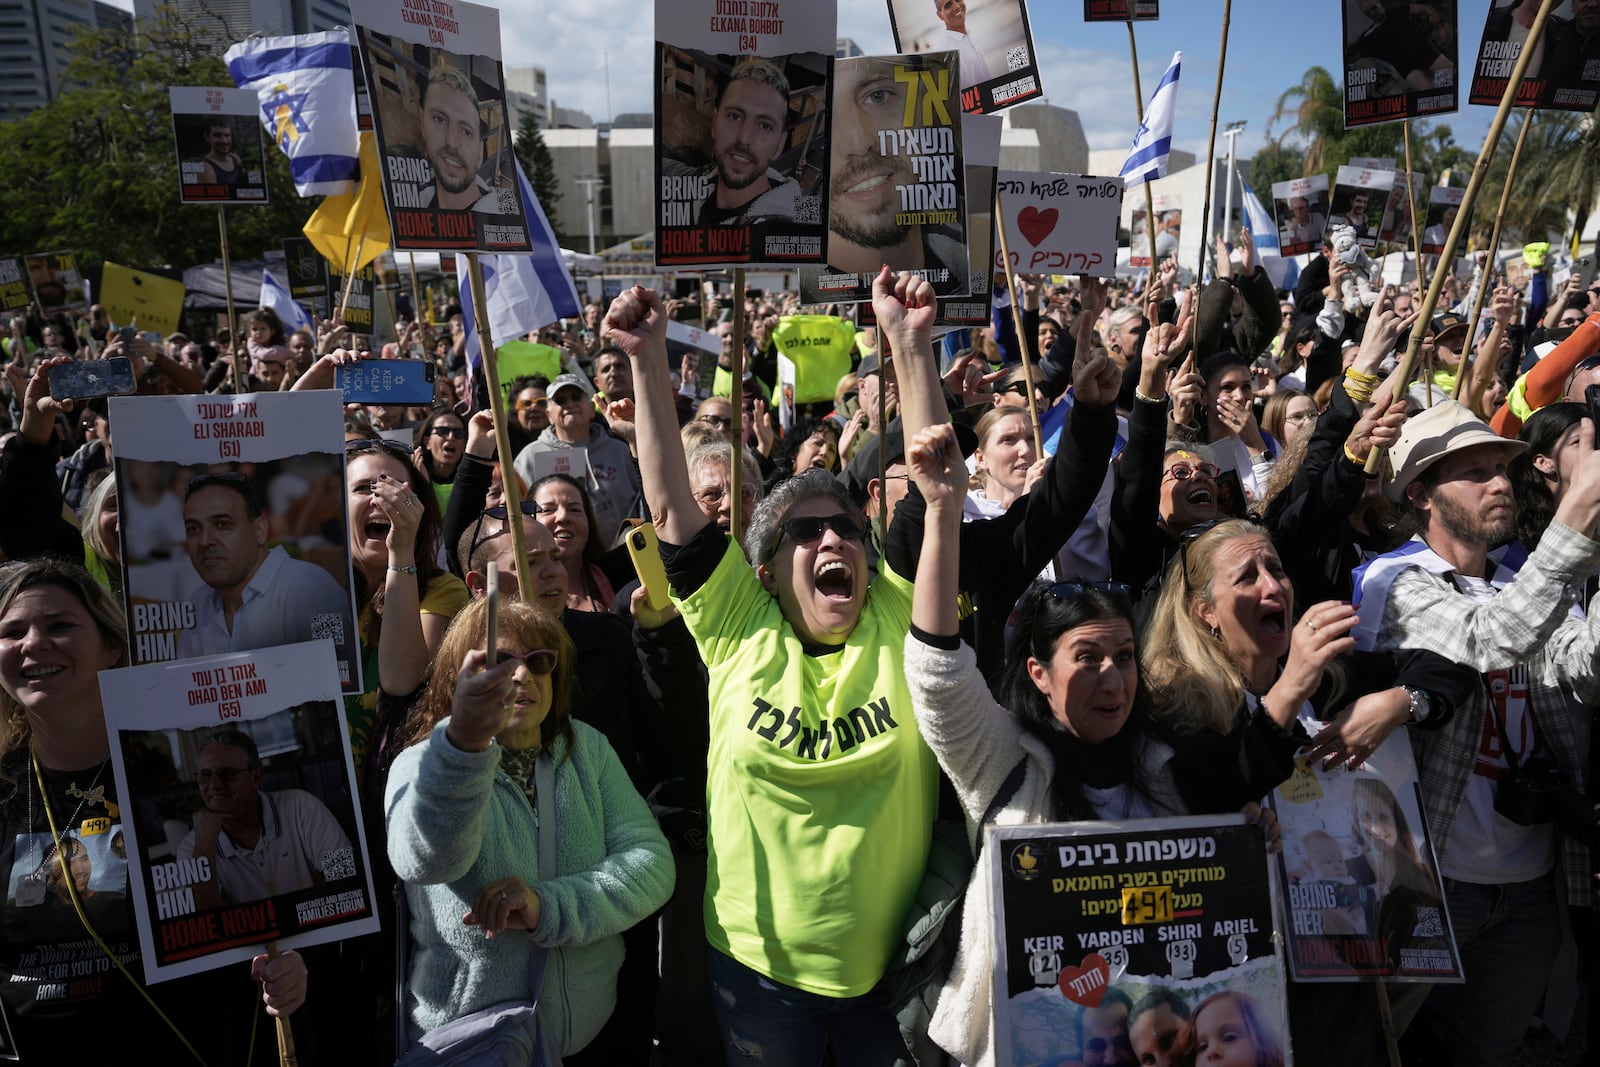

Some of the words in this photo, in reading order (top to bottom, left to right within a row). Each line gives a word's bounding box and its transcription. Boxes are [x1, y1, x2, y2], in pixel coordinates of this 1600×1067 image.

[716, 0, 748, 16] בוחבוט
[750, 1, 779, 18] אלקנה
[402, 10, 433, 27] ELKANA
[434, 16, 460, 35] BOHBOT
[711, 17, 747, 33] ELKANA
[749, 18, 784, 35] BOHBOT
[738, 34, 757, 51] (34)
[1482, 40, 1521, 60] BRING
[1348, 67, 1377, 86] BRING
[1480, 59, 1516, 78] THEM
[894, 66, 952, 127] אל
[1348, 85, 1367, 102] HIM
[1349, 100, 1377, 118] HOME
[1378, 94, 1407, 115] NOW!
[878, 128, 954, 157] תשאירו
[182, 162, 205, 173] BRING
[182, 173, 198, 184] HIM
[387, 156, 431, 184] BRING
[911, 155, 955, 182] אותי
[392, 182, 420, 208] HIM
[662, 175, 710, 200] BRING
[896, 182, 957, 211] מאחור
[1076, 182, 1117, 198] סליחה
[396, 212, 436, 237] HOME
[437, 212, 476, 238] NOW!
[662, 202, 690, 226] HIM
[928, 211, 958, 224] אלקנה
[662, 230, 704, 254] HOME
[708, 226, 750, 252] NOW!
[765, 244, 796, 256] FAMILIES
[796, 243, 821, 256] FORUM
[1030, 252, 1102, 270] ברוכים
[355, 368, 363, 390] FUCK
[371, 368, 380, 392] CALM
[383, 370, 392, 390] KEEP
[197, 404, 234, 420] שרעבי
[238, 402, 258, 418] אלי
[194, 423, 210, 440] ELI
[213, 422, 264, 438] SHARABI
[219, 440, 241, 458] (51)
[134, 602, 196, 632] BRING
[136, 632, 177, 662] HIM
[192, 670, 212, 686] עמי
[216, 668, 226, 685] בן
[228, 664, 257, 680] אוהד
[188, 689, 218, 706] OHAD
[220, 684, 243, 702] BEN
[246, 679, 268, 698] AMI
[218, 702, 242, 720] (55)
[747, 697, 802, 748] לבד
[832, 696, 899, 752] אתם
[798, 720, 832, 760] לא
[1058, 842, 1118, 868] ביבס
[1126, 836, 1216, 864] משפחת
[152, 855, 212, 893] BRING
[1052, 874, 1115, 894] החמאס
[1118, 870, 1158, 888] בשבי
[1162, 866, 1226, 888] מוחזקים
[156, 887, 196, 920] HIM
[296, 896, 325, 912] HOSTAGES
[325, 894, 338, 904] AND
[338, 889, 363, 902] MISSING
[1290, 884, 1336, 910] BRING
[298, 904, 335, 924] FAMILIES
[336, 897, 365, 916] FORUM
[161, 913, 218, 951] HOME
[222, 900, 278, 936] NOW!
[1077, 928, 1145, 948] YARDEN
[1157, 922, 1202, 942] SHIRI
[1213, 918, 1258, 936] ARIEL
[1292, 910, 1324, 936] HER
[1296, 938, 1342, 964] HOME
[48, 962, 68, 979] FOR
[71, 960, 93, 976] YOU
[96, 958, 110, 972] TO
[1401, 956, 1430, 969] FAMILIES
[1431, 956, 1453, 969] FORUM
[36, 982, 68, 1000] HOME
